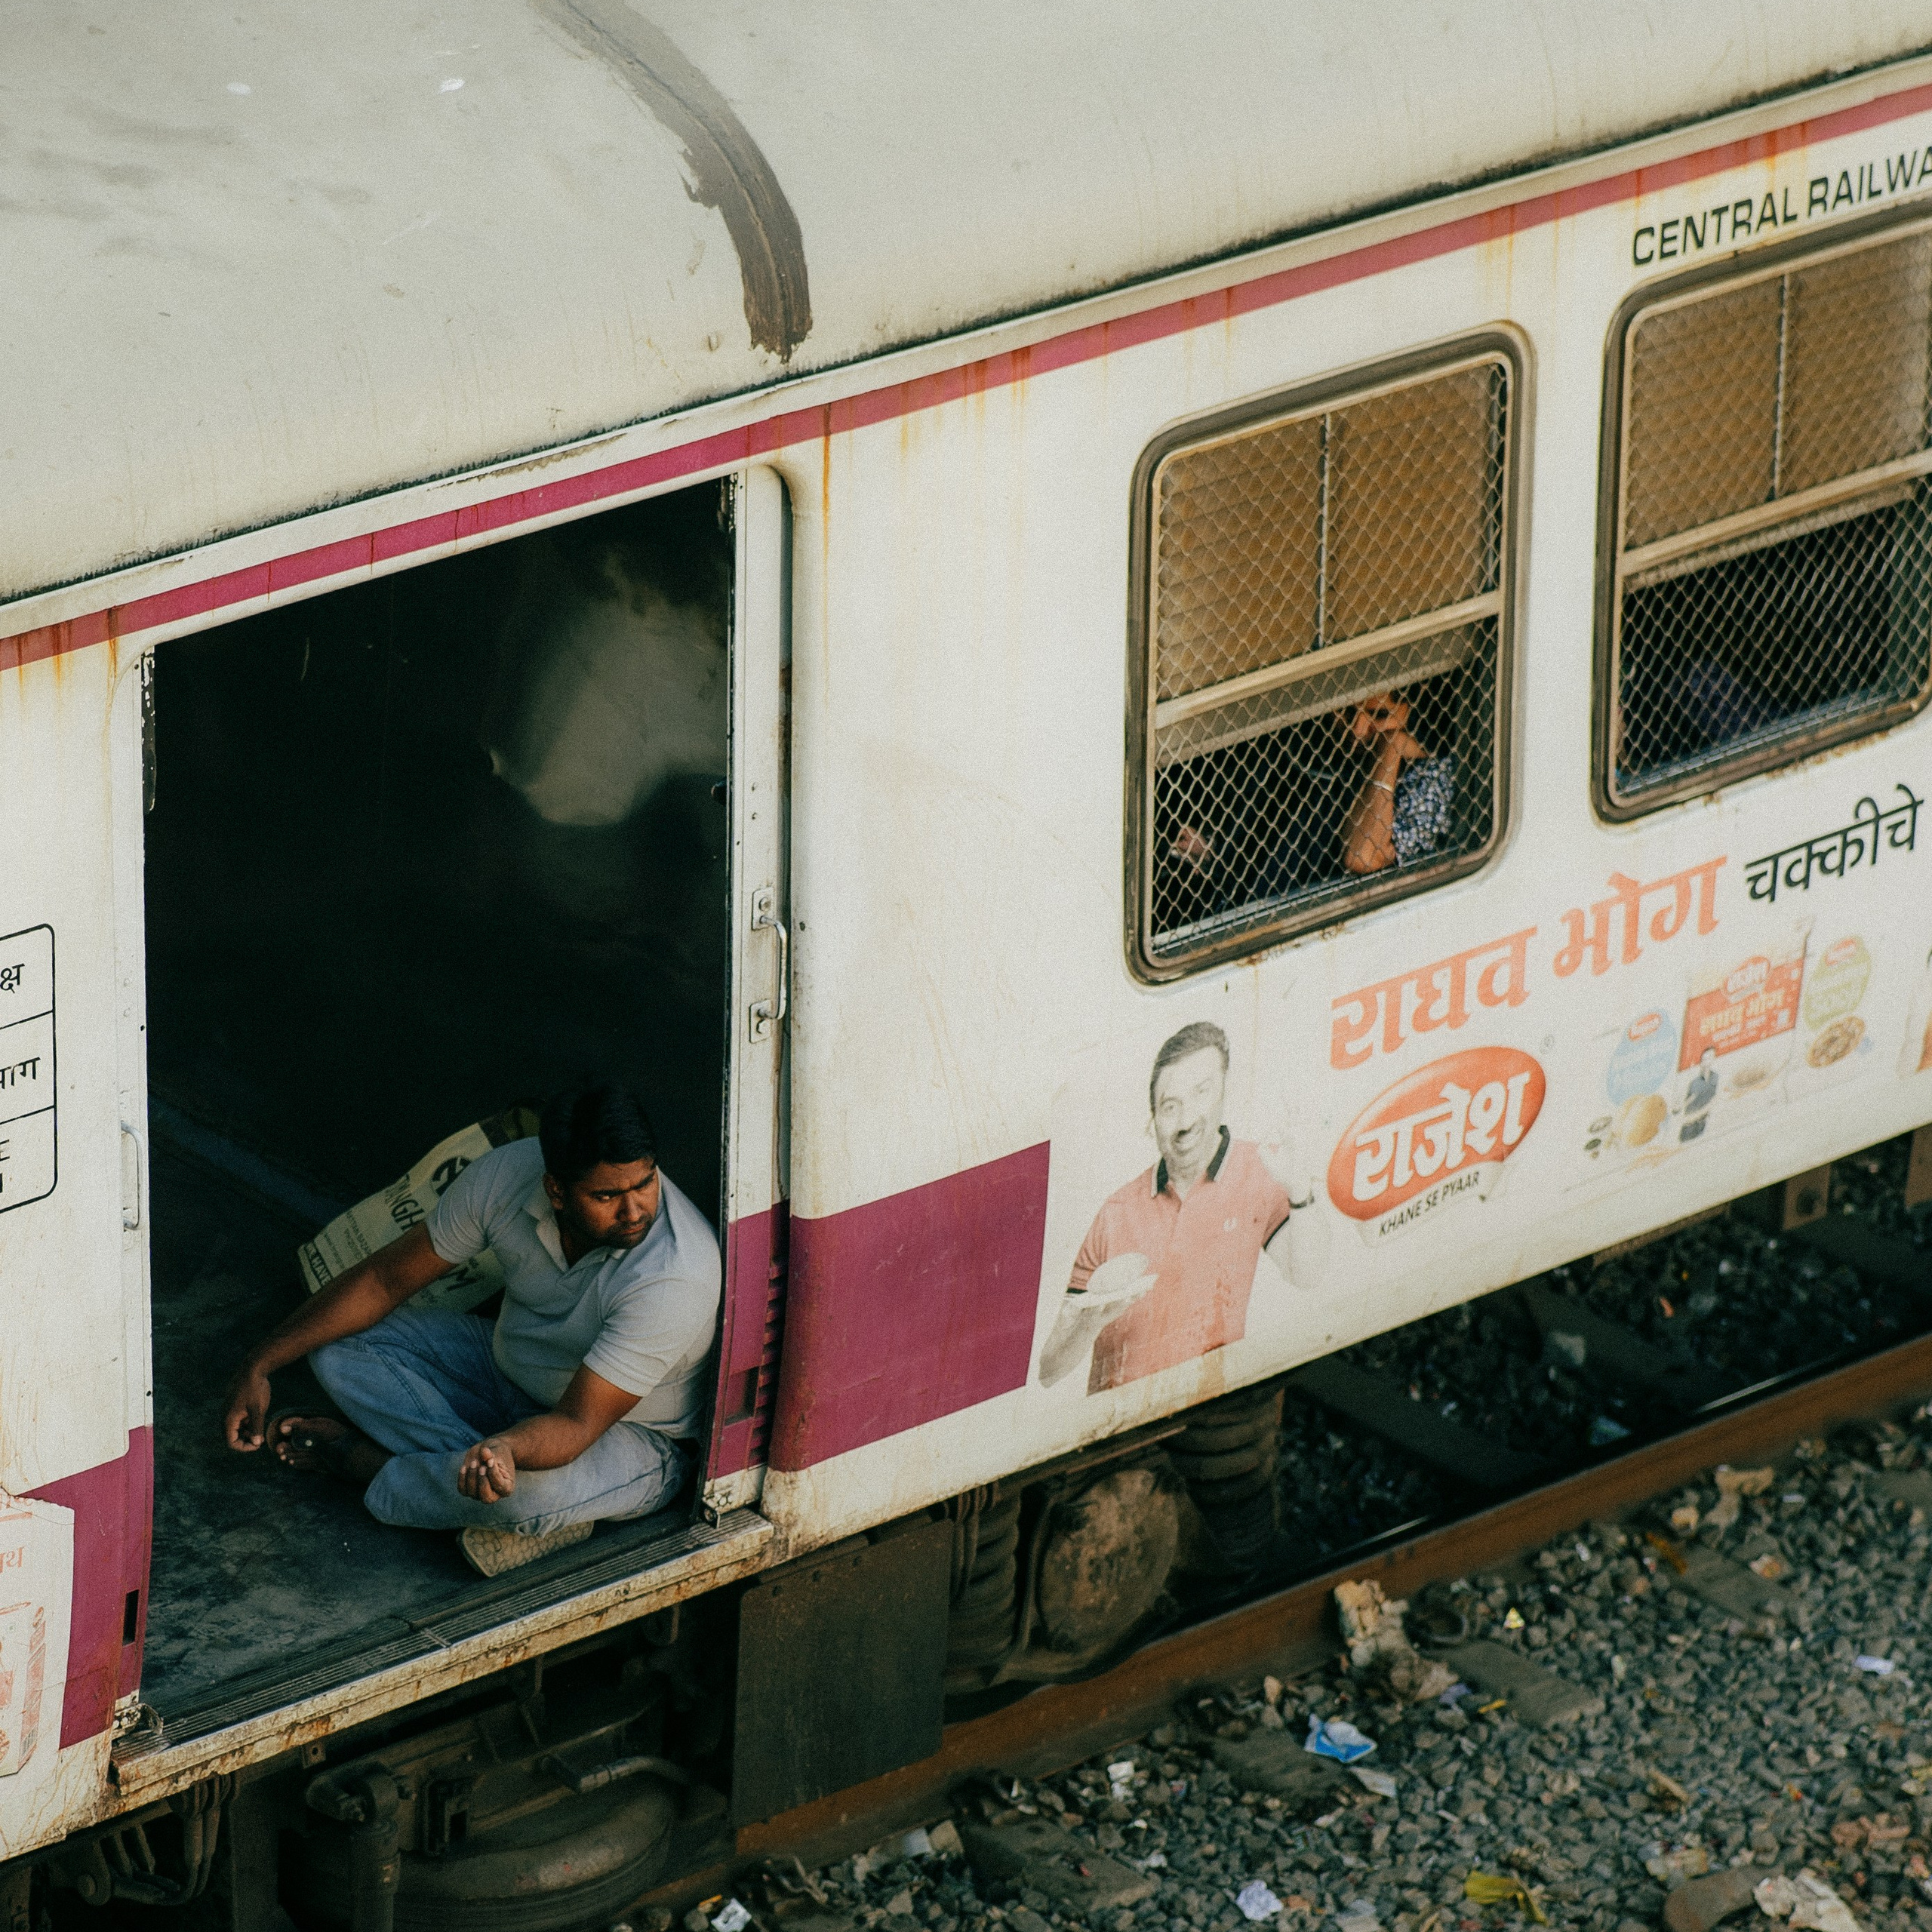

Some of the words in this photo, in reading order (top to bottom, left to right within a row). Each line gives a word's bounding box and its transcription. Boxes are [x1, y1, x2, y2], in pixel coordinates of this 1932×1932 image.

[1632, 187, 1798, 266] CENTRAL
[1329, 925, 1538, 1070] राघव
[1552, 855, 1727, 977] भोग
[1743, 783, 1924, 903] चक्कीचे
[1352, 1069, 1532, 1202] राजेश
[1378, 1200, 1423, 1238] KHANE
[1424, 1189, 1438, 1212] SE
[1441, 1171, 1480, 1201] PYAAR
